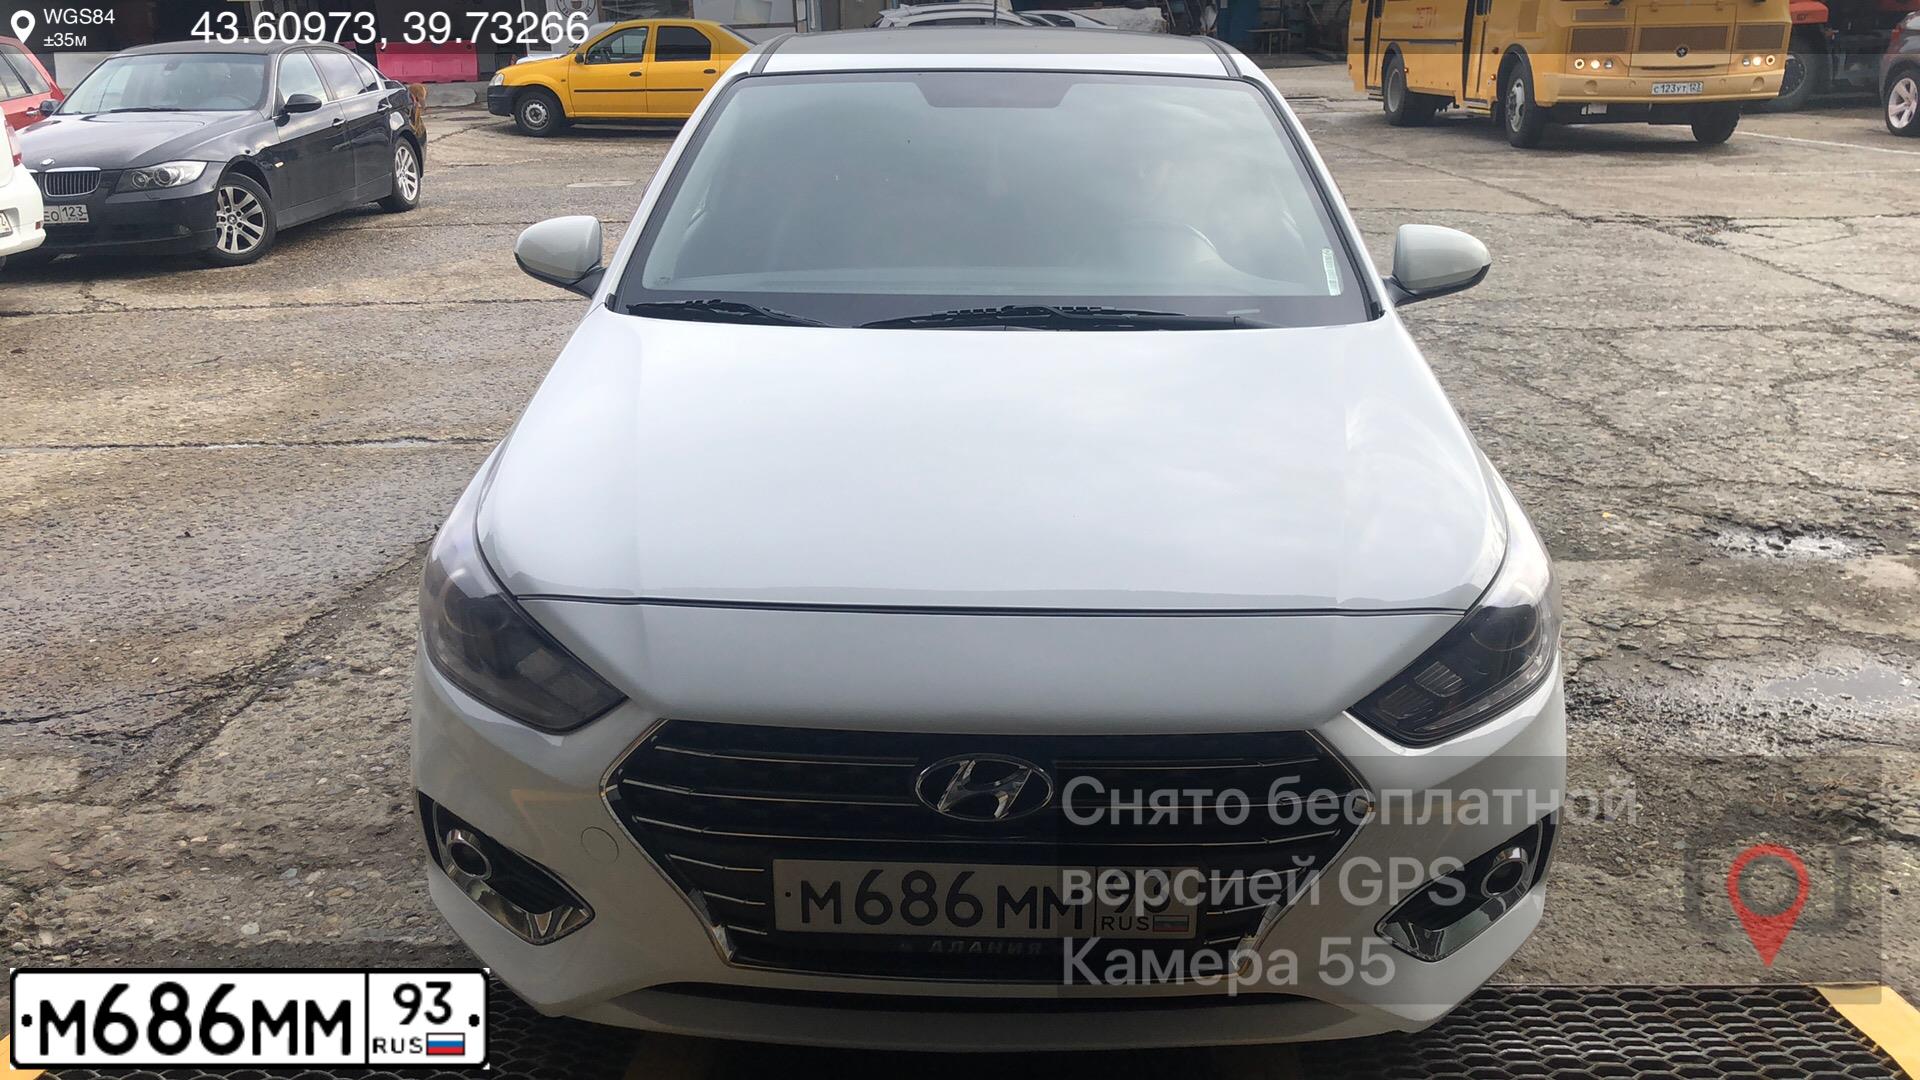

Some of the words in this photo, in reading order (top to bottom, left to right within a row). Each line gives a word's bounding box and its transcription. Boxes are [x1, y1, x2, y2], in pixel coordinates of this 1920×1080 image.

[62, 206, 83, 218] 123
[1100, 915, 1150, 931] RUS
[928, 939, 1044, 955] АЛАНИЯ
